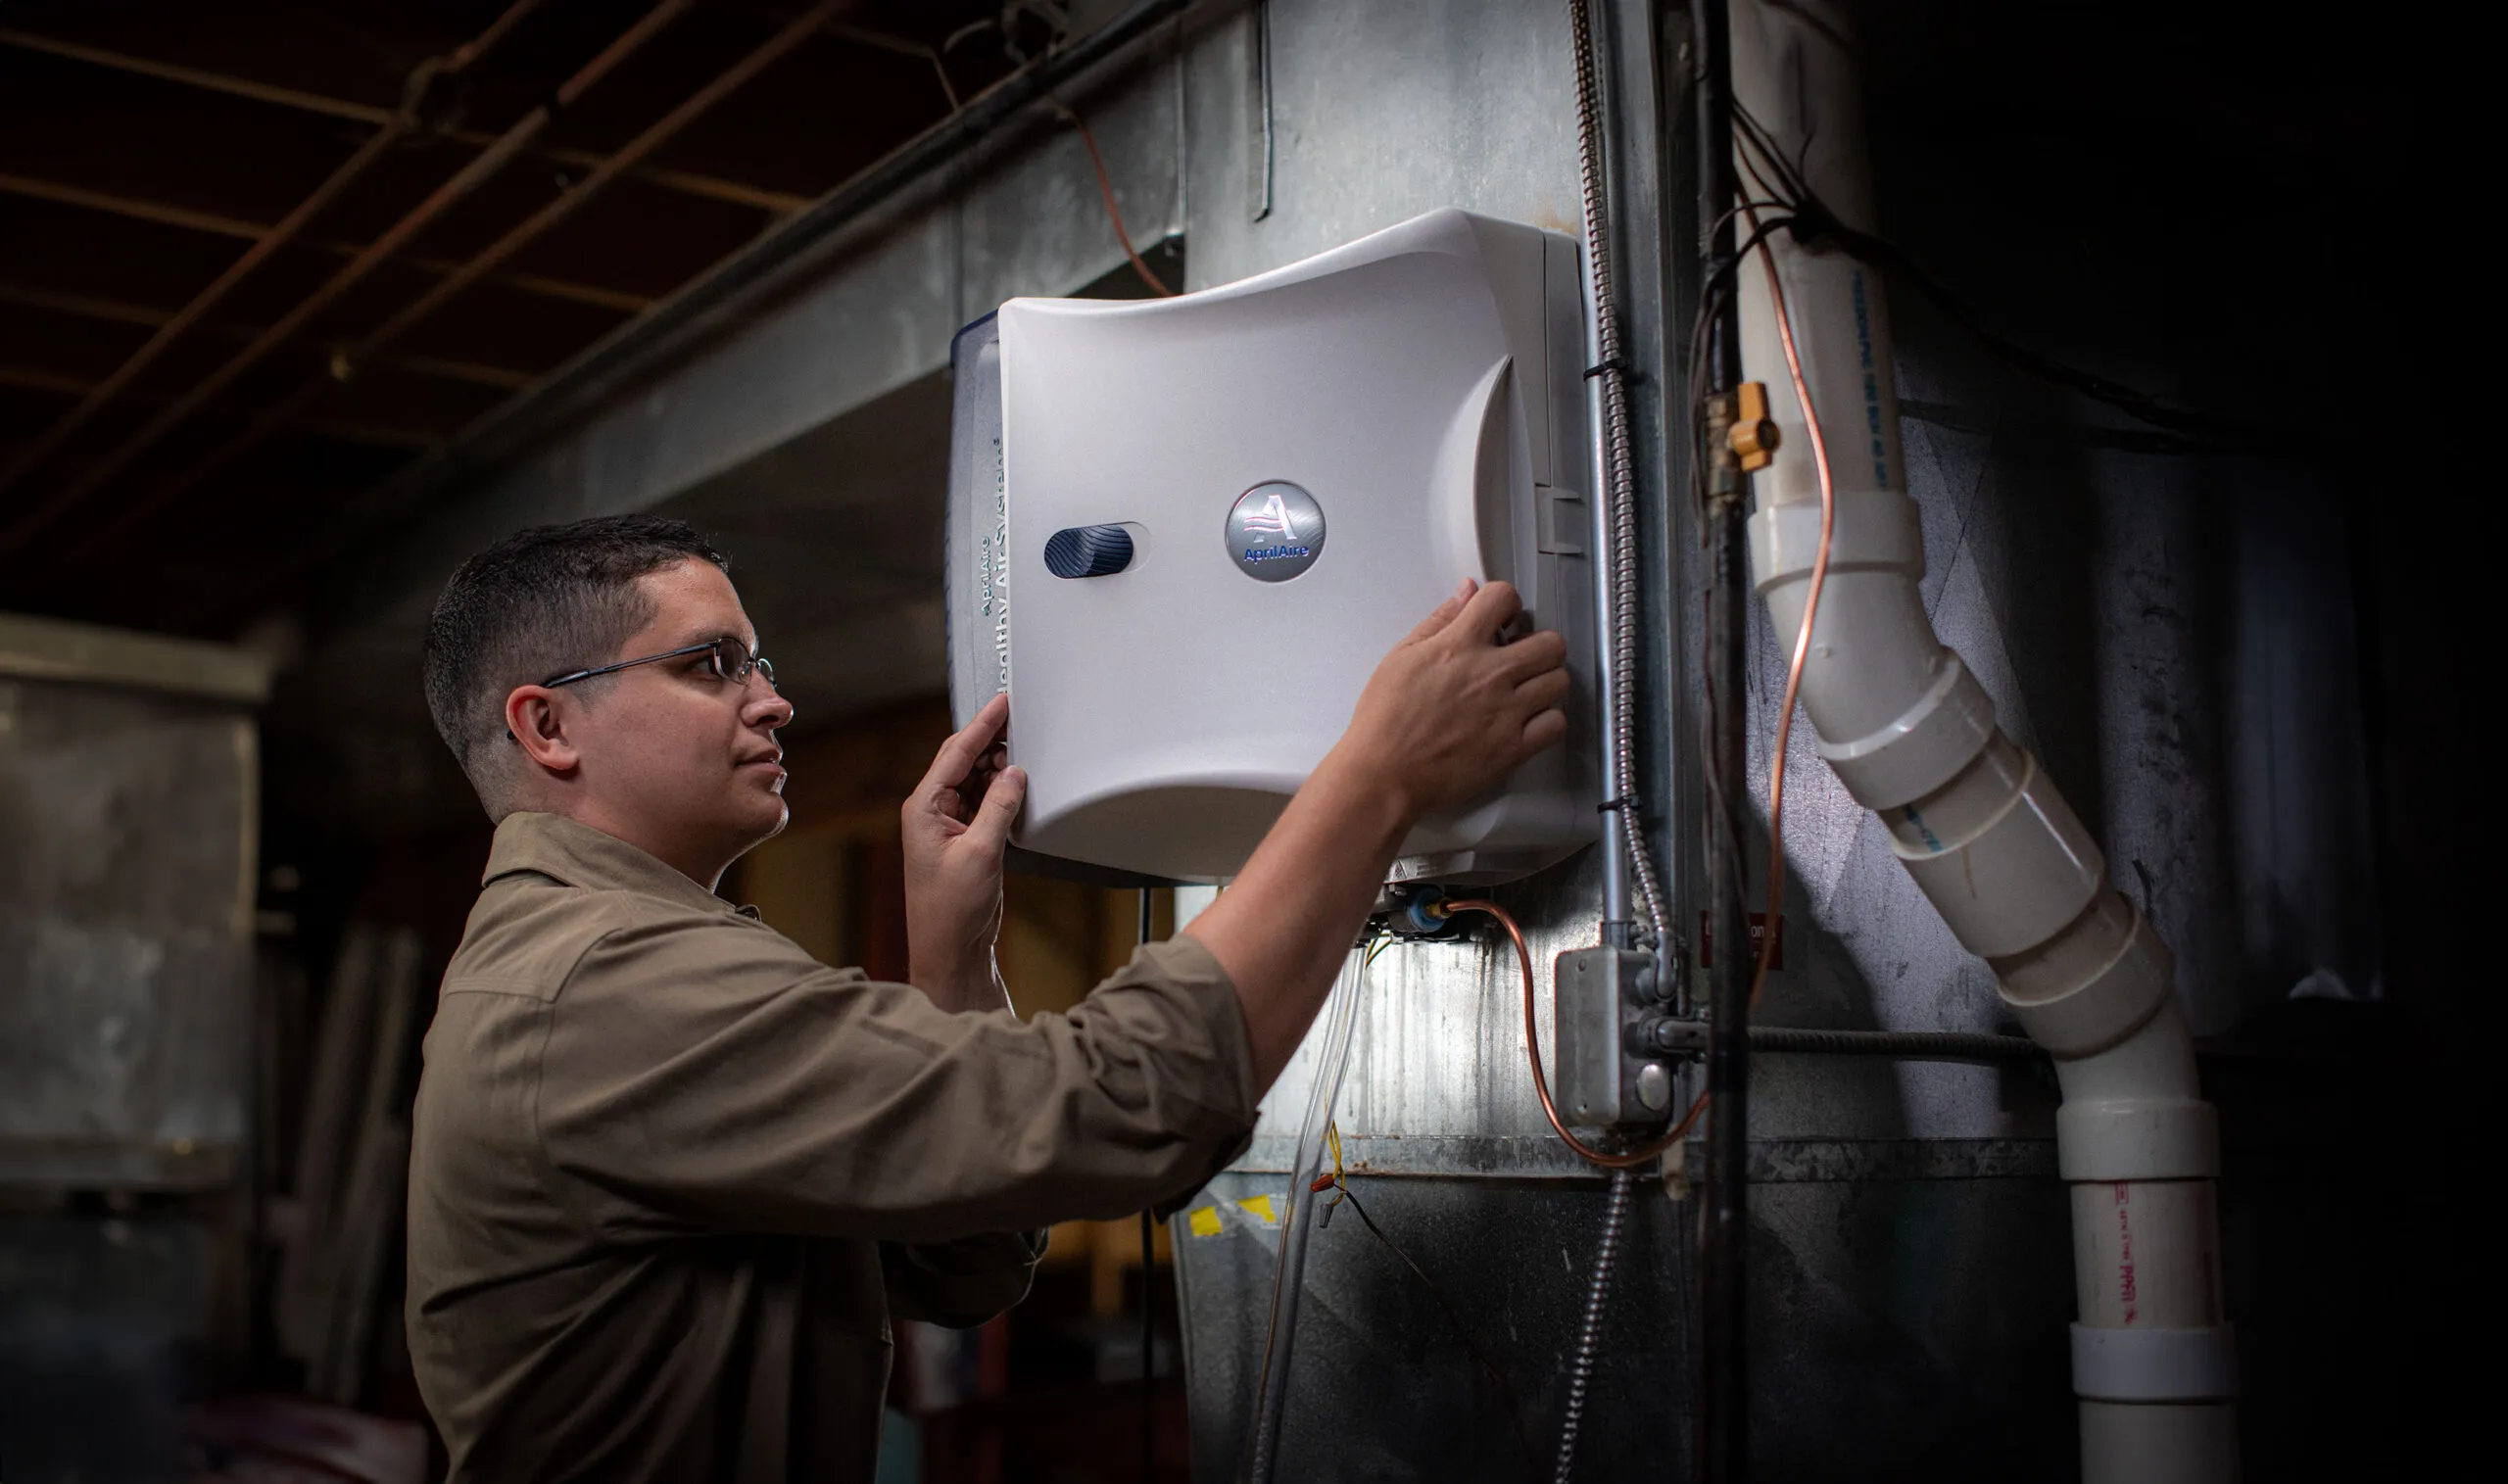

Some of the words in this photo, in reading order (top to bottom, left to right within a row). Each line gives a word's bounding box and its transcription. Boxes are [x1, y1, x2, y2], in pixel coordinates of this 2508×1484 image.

[993, 551, 1007, 587] Air
[1243, 545, 1310, 565] AprilAire
[980, 536, 994, 617] AprilAire
